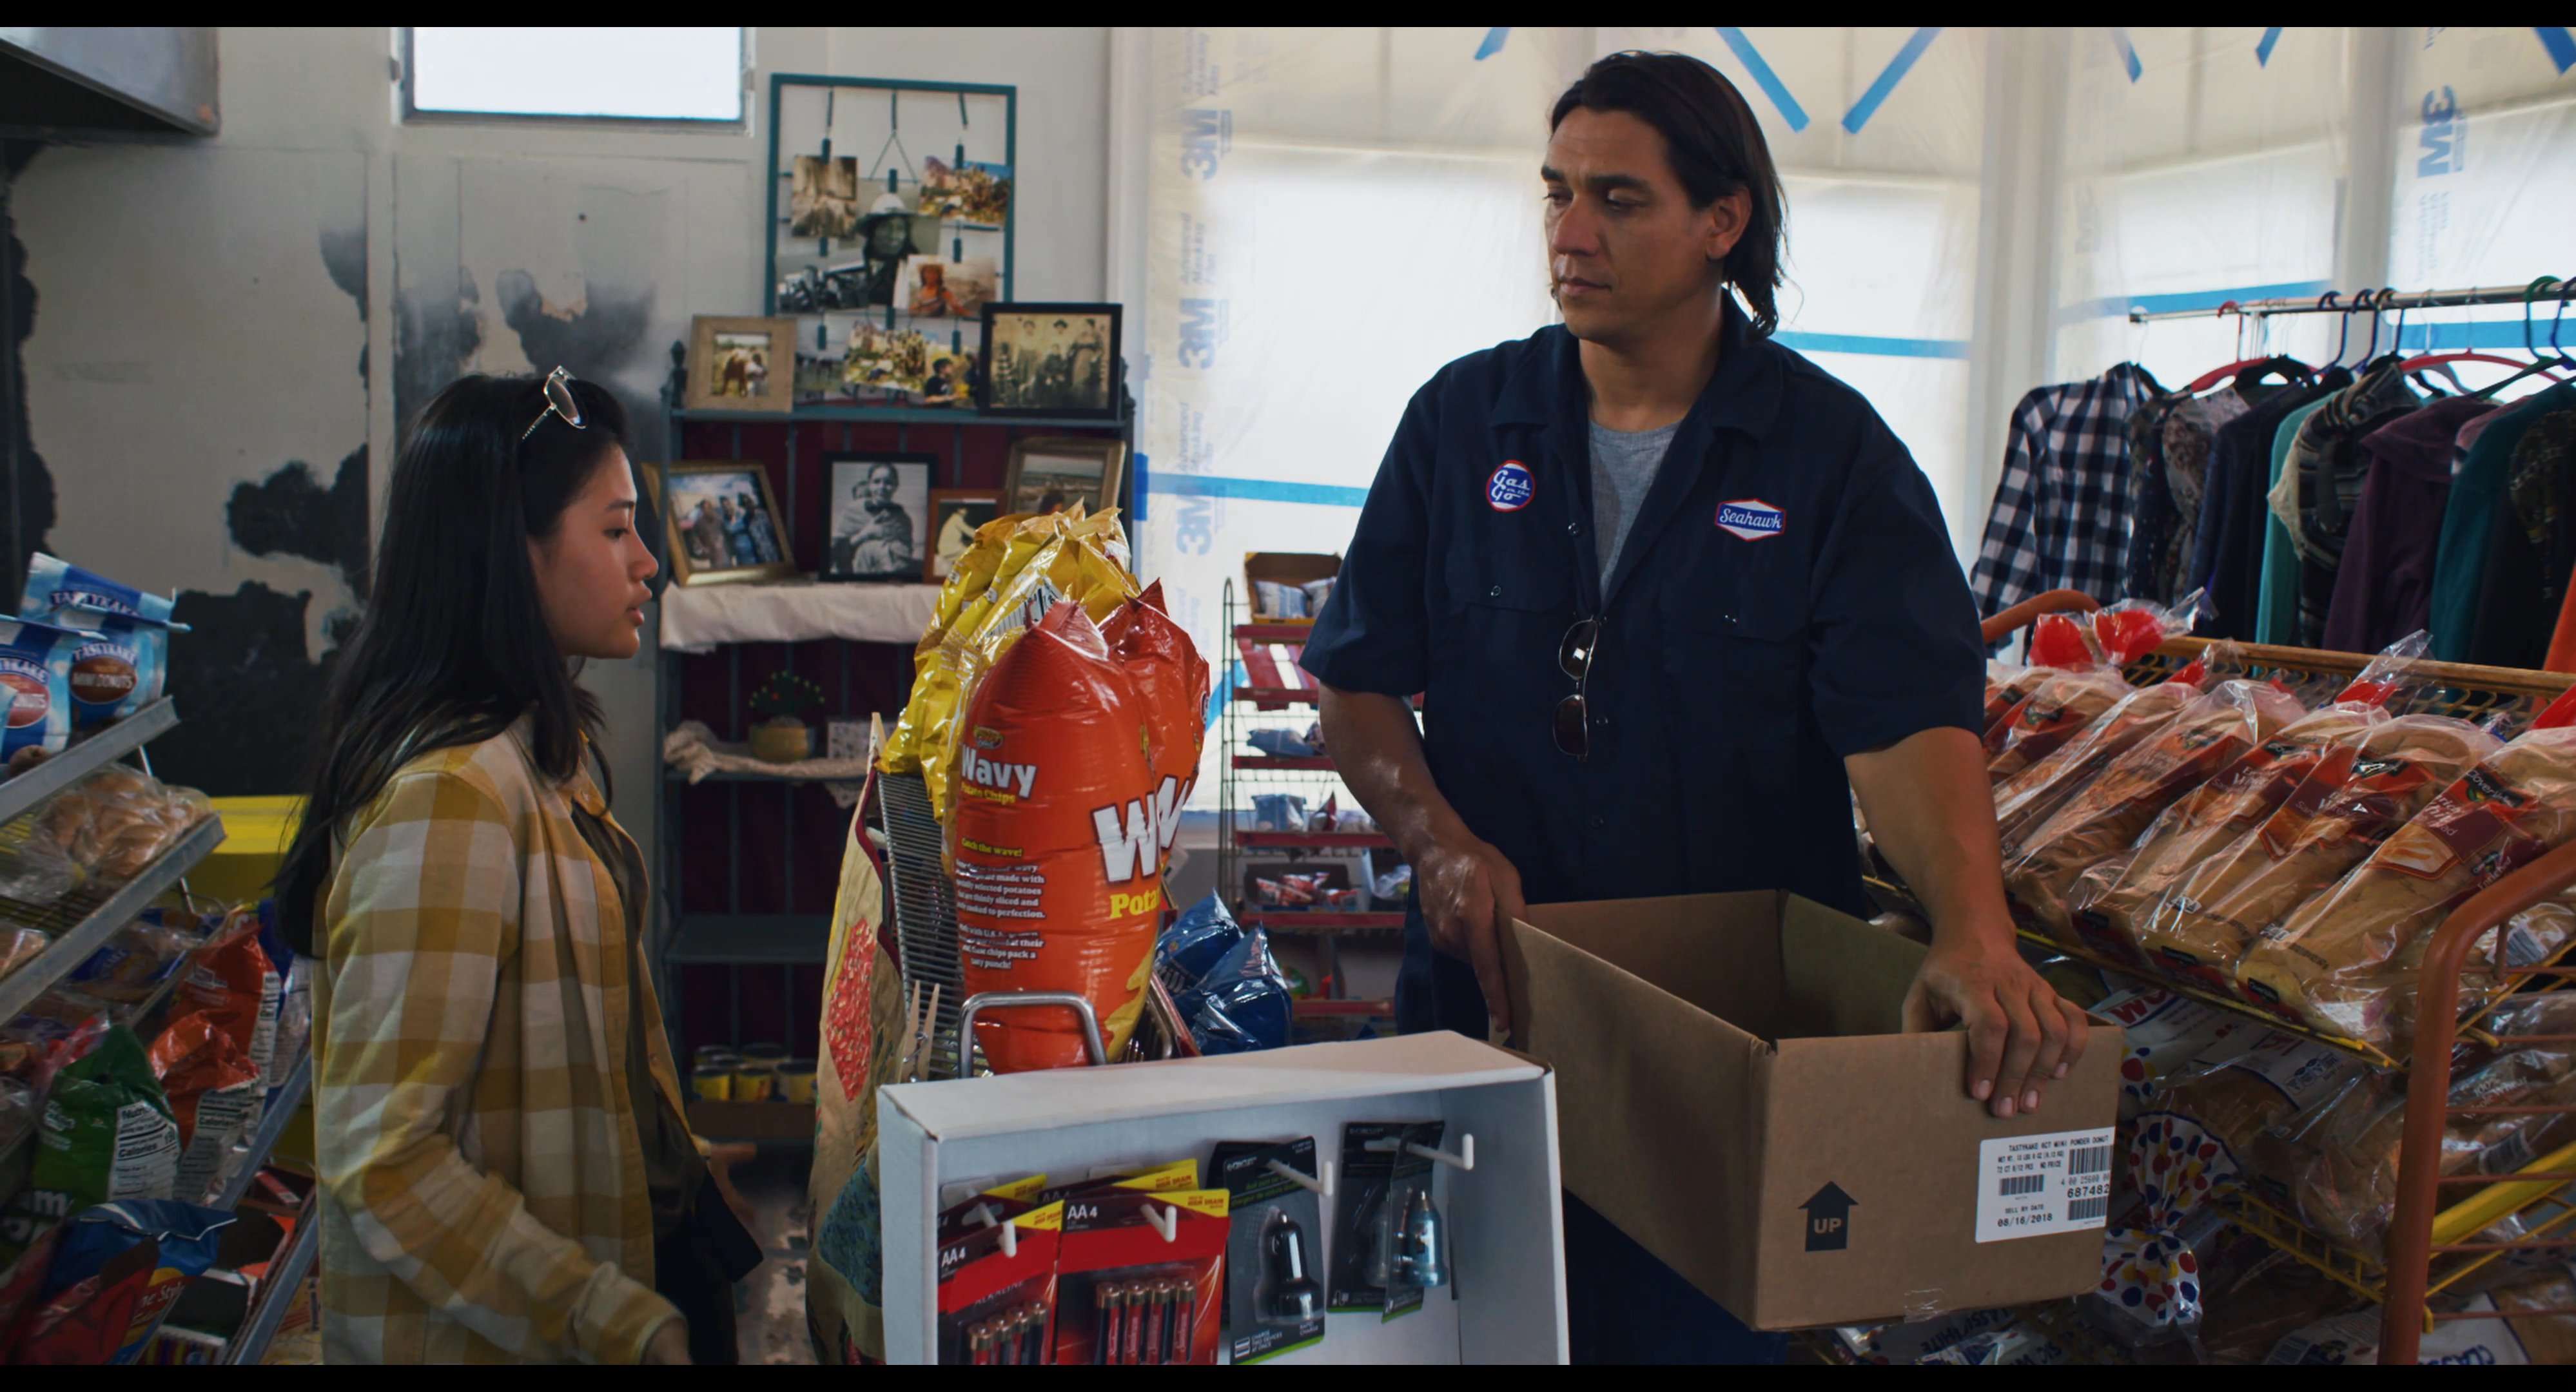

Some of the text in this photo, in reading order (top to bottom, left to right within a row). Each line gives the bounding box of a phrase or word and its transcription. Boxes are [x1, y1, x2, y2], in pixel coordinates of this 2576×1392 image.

[1180, 108, 1218, 180] 3M
[1178, 298, 1216, 369] 3M
[1493, 470, 1530, 491] Gas
[1490, 485, 1522, 501] Go
[1176, 485, 1212, 556] 3M
[1719, 508, 1782, 528] Seahawk
[962, 744, 1037, 798] Wavy
[993, 846, 1023, 858] wave!
[996, 874, 1020, 883] made
[1021, 875, 1045, 884] with
[1002, 885, 1043, 896] potatoes
[995, 897, 1020, 906] sliced
[1020, 898, 1039, 907] and
[997, 908, 1046, 919] perfection.
[1020, 939, 1044, 948] their
[1007, 951, 1029, 960] pack
[119, 1143, 157, 1157] Calories
[2009, 1142, 2038, 1152] TASTYKAKE
[2071, 1137, 2090, 1146] POWDER
[2092, 1135, 2109, 1144] DONUT
[2047, 1160, 2062, 1168] PRICE
[2067, 1183, 2110, 1198] 687482
[1067, 1204, 1098, 1220] AA 4
[1813, 1217, 1842, 1234] UP
[1997, 1213, 2053, 1227] 08/16/2018
